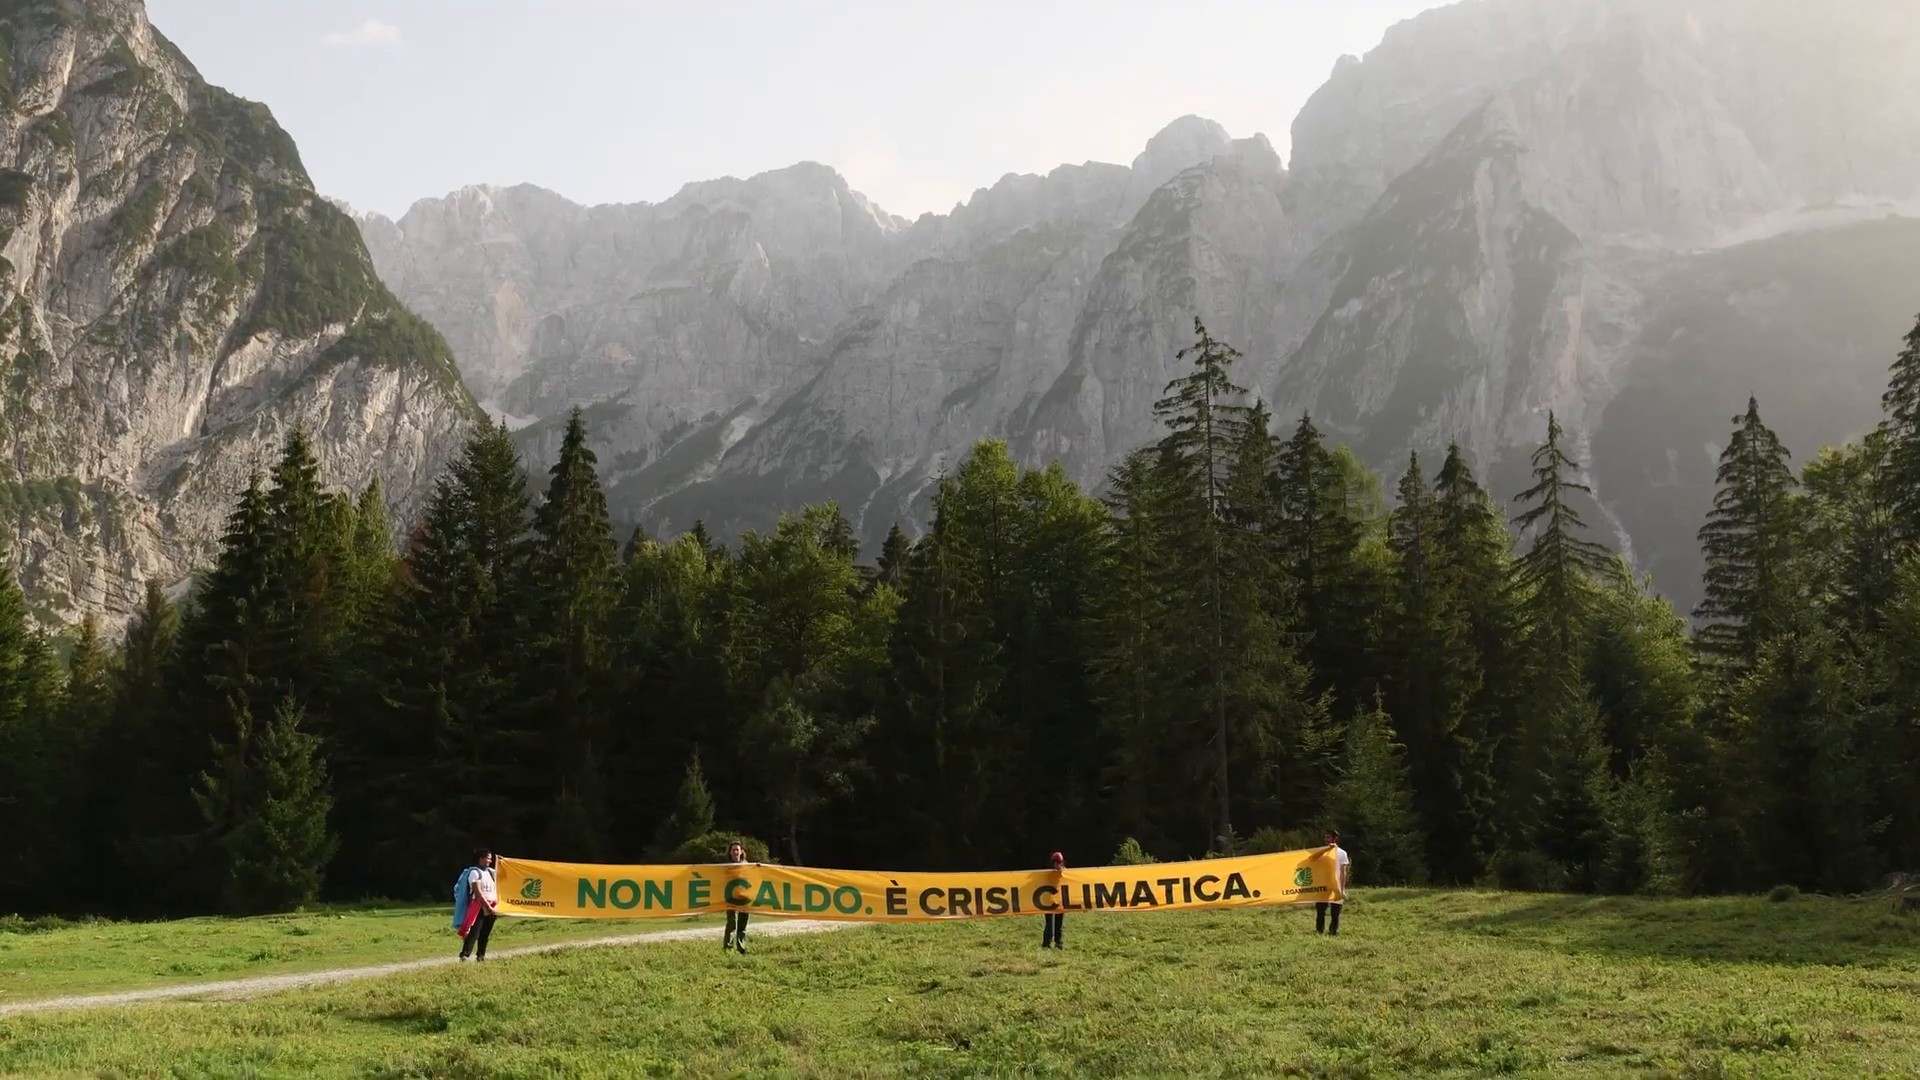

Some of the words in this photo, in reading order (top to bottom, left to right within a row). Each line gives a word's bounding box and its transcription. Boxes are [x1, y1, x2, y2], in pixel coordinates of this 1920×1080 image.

[577, 878, 673, 910] NON
[688, 872, 711, 908] È
[724, 878, 872, 915] CALDO.
[887, 880, 908, 915] È
[919, 887, 1020, 916] CRISI
[1032, 872, 1261, 911] CLIMATICA.
[1282, 886, 1328, 896] LEGAMBIENTE
[507, 898, 555, 908] LEGAMBIENTE
